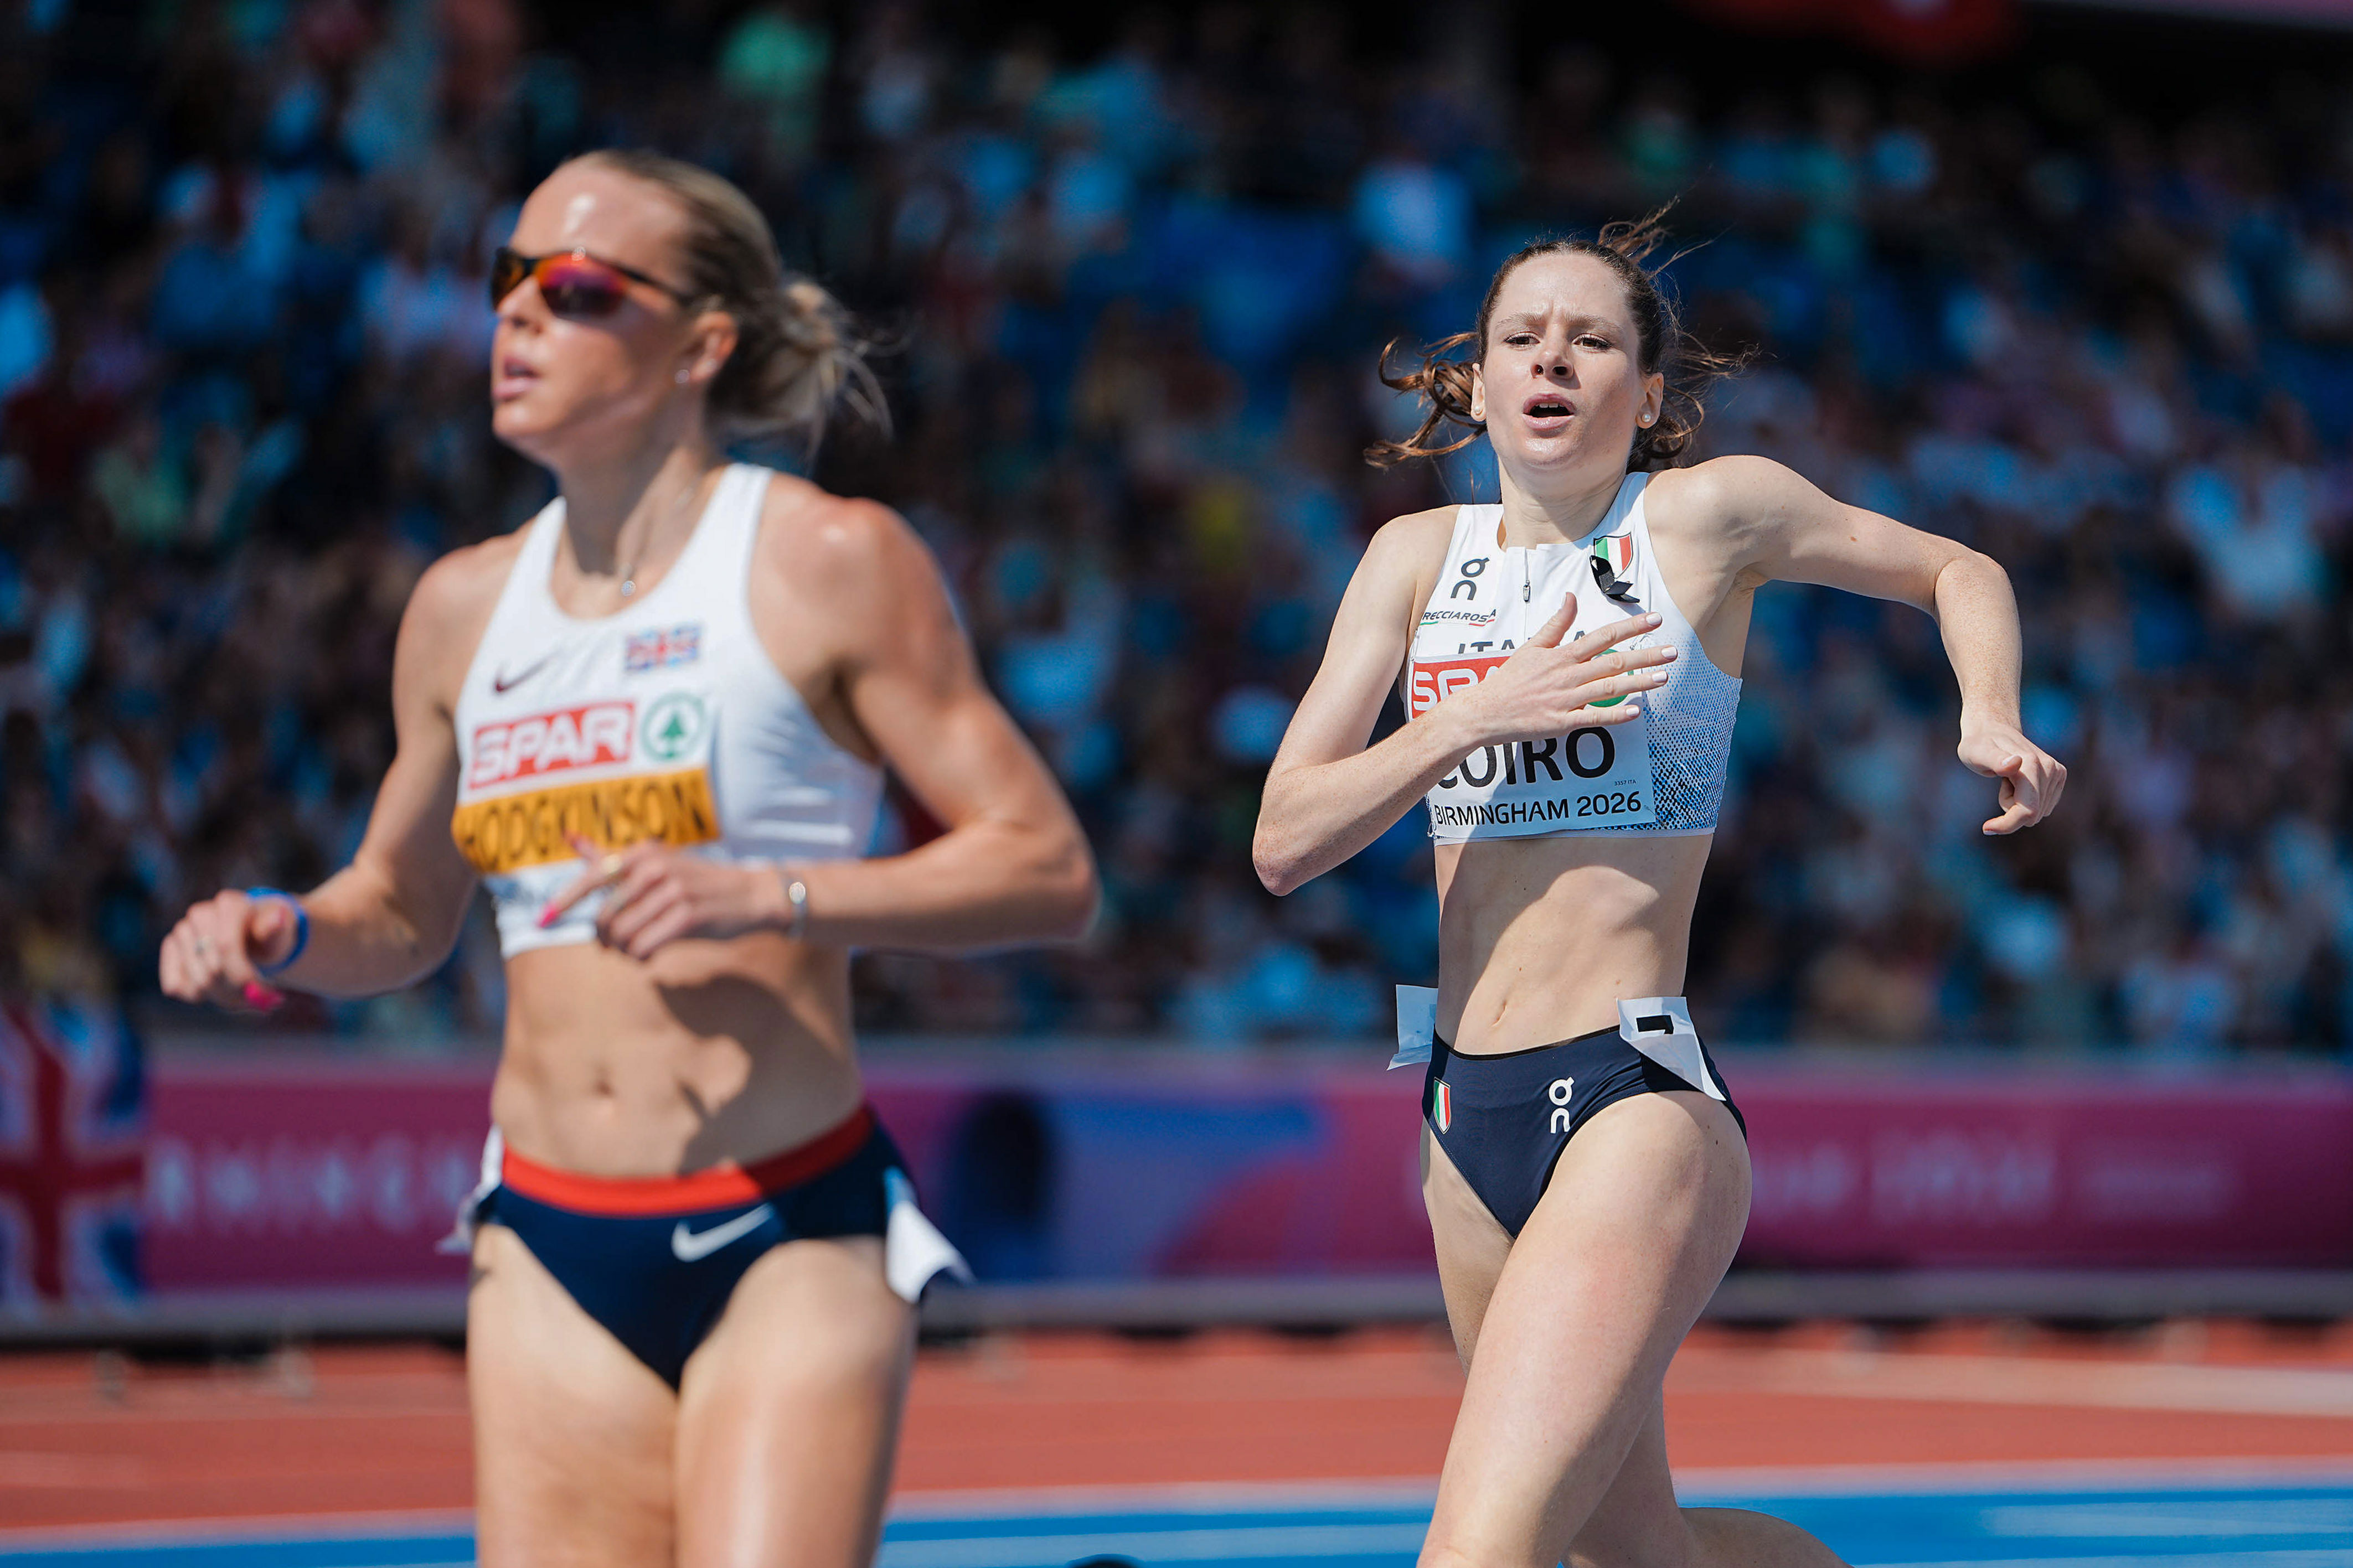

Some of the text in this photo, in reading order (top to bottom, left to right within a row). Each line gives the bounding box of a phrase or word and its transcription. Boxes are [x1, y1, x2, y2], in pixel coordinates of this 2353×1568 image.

[1421, 608, 1497, 623] RECCIAROSA
[1412, 665, 1500, 712] SP
[474, 706, 628, 784] SPAR
[1437, 726, 1616, 789] OIRO
[1434, 790, 1642, 826] BIRMINGHAM 2026
